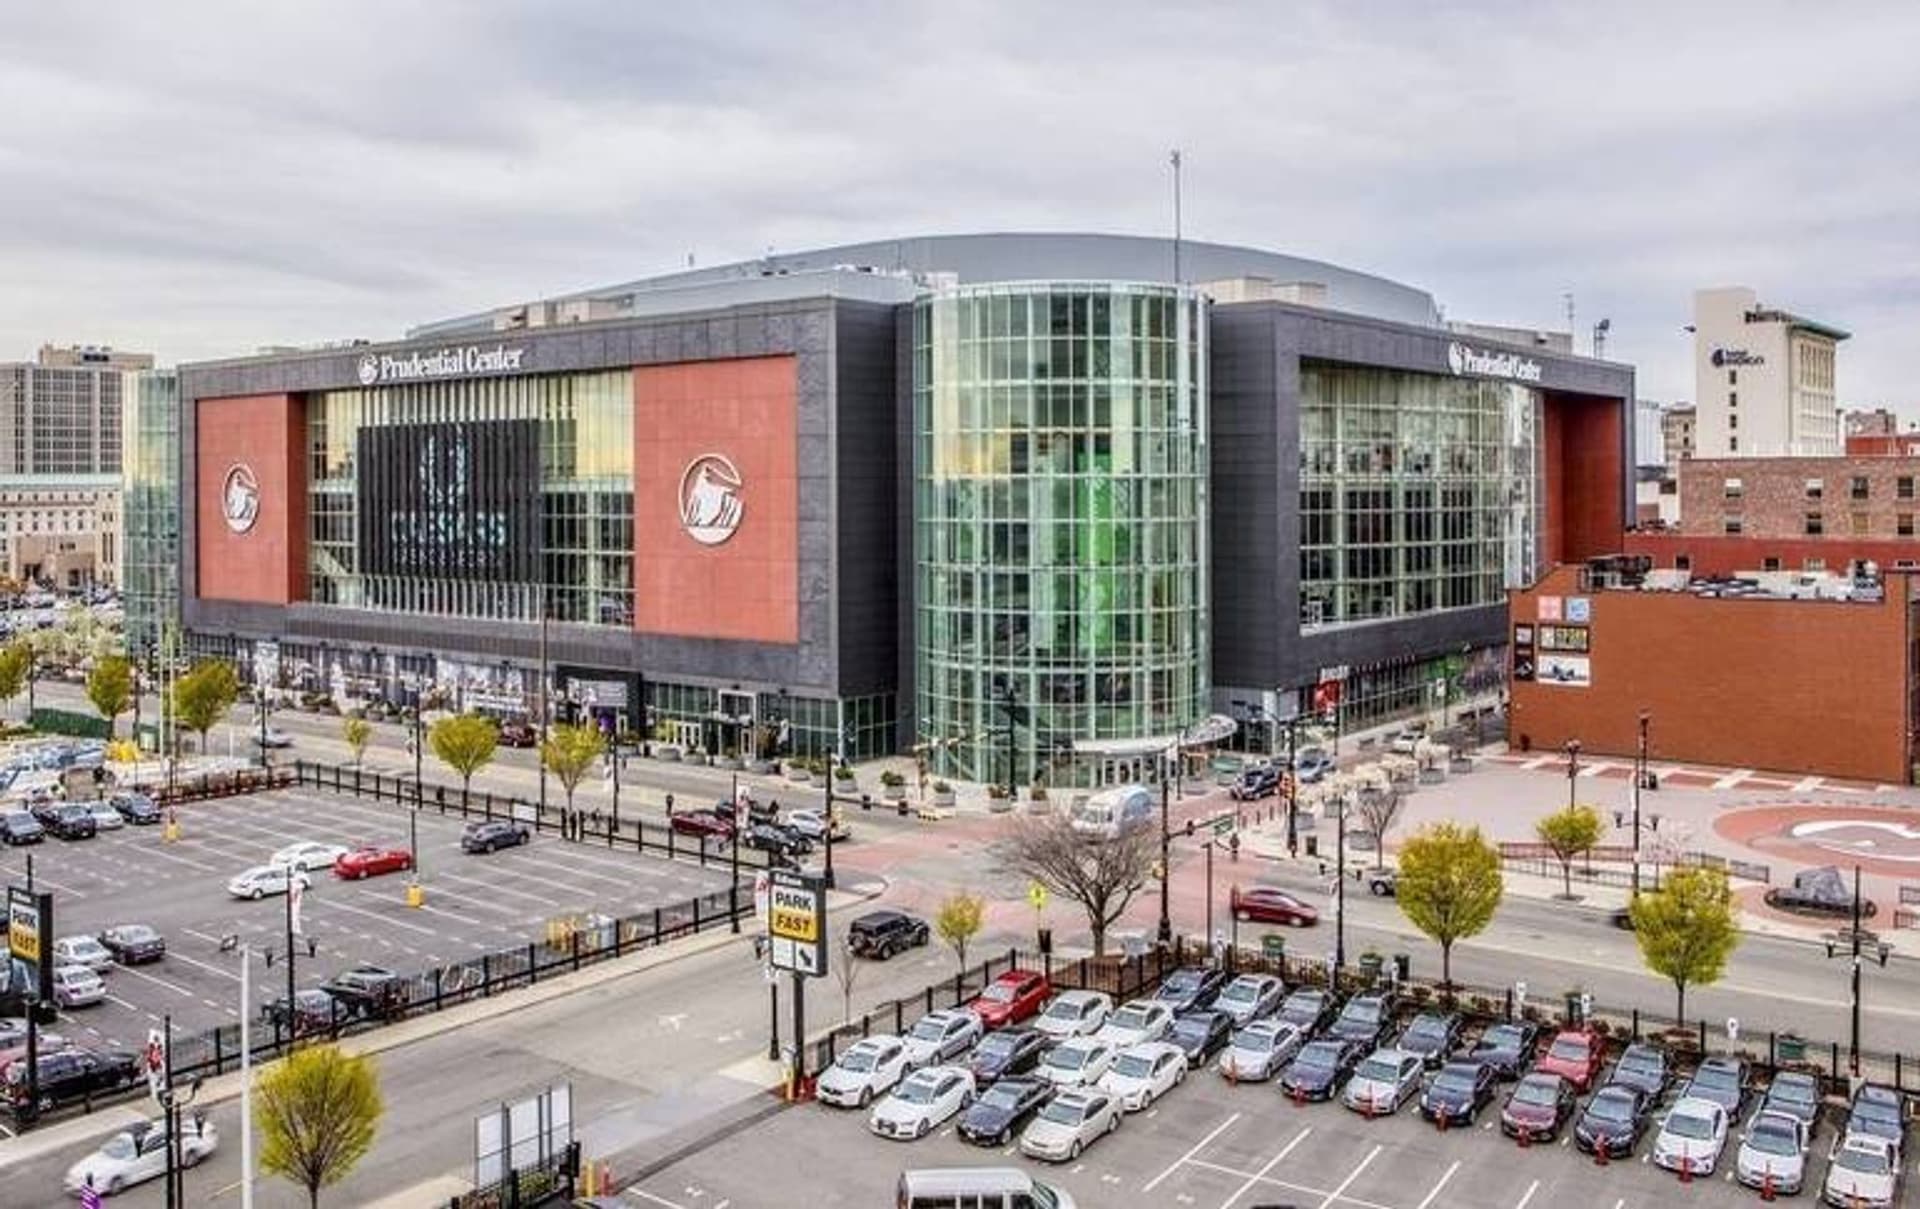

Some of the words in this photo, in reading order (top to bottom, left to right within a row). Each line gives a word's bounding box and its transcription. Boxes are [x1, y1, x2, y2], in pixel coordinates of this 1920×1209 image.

[381, 349, 463, 379] Prudential
[466, 344, 523, 372] Center
[1463, 347, 1513, 377] Prudential
[1513, 354, 1541, 380] Center
[776, 891, 812, 911] PARK
